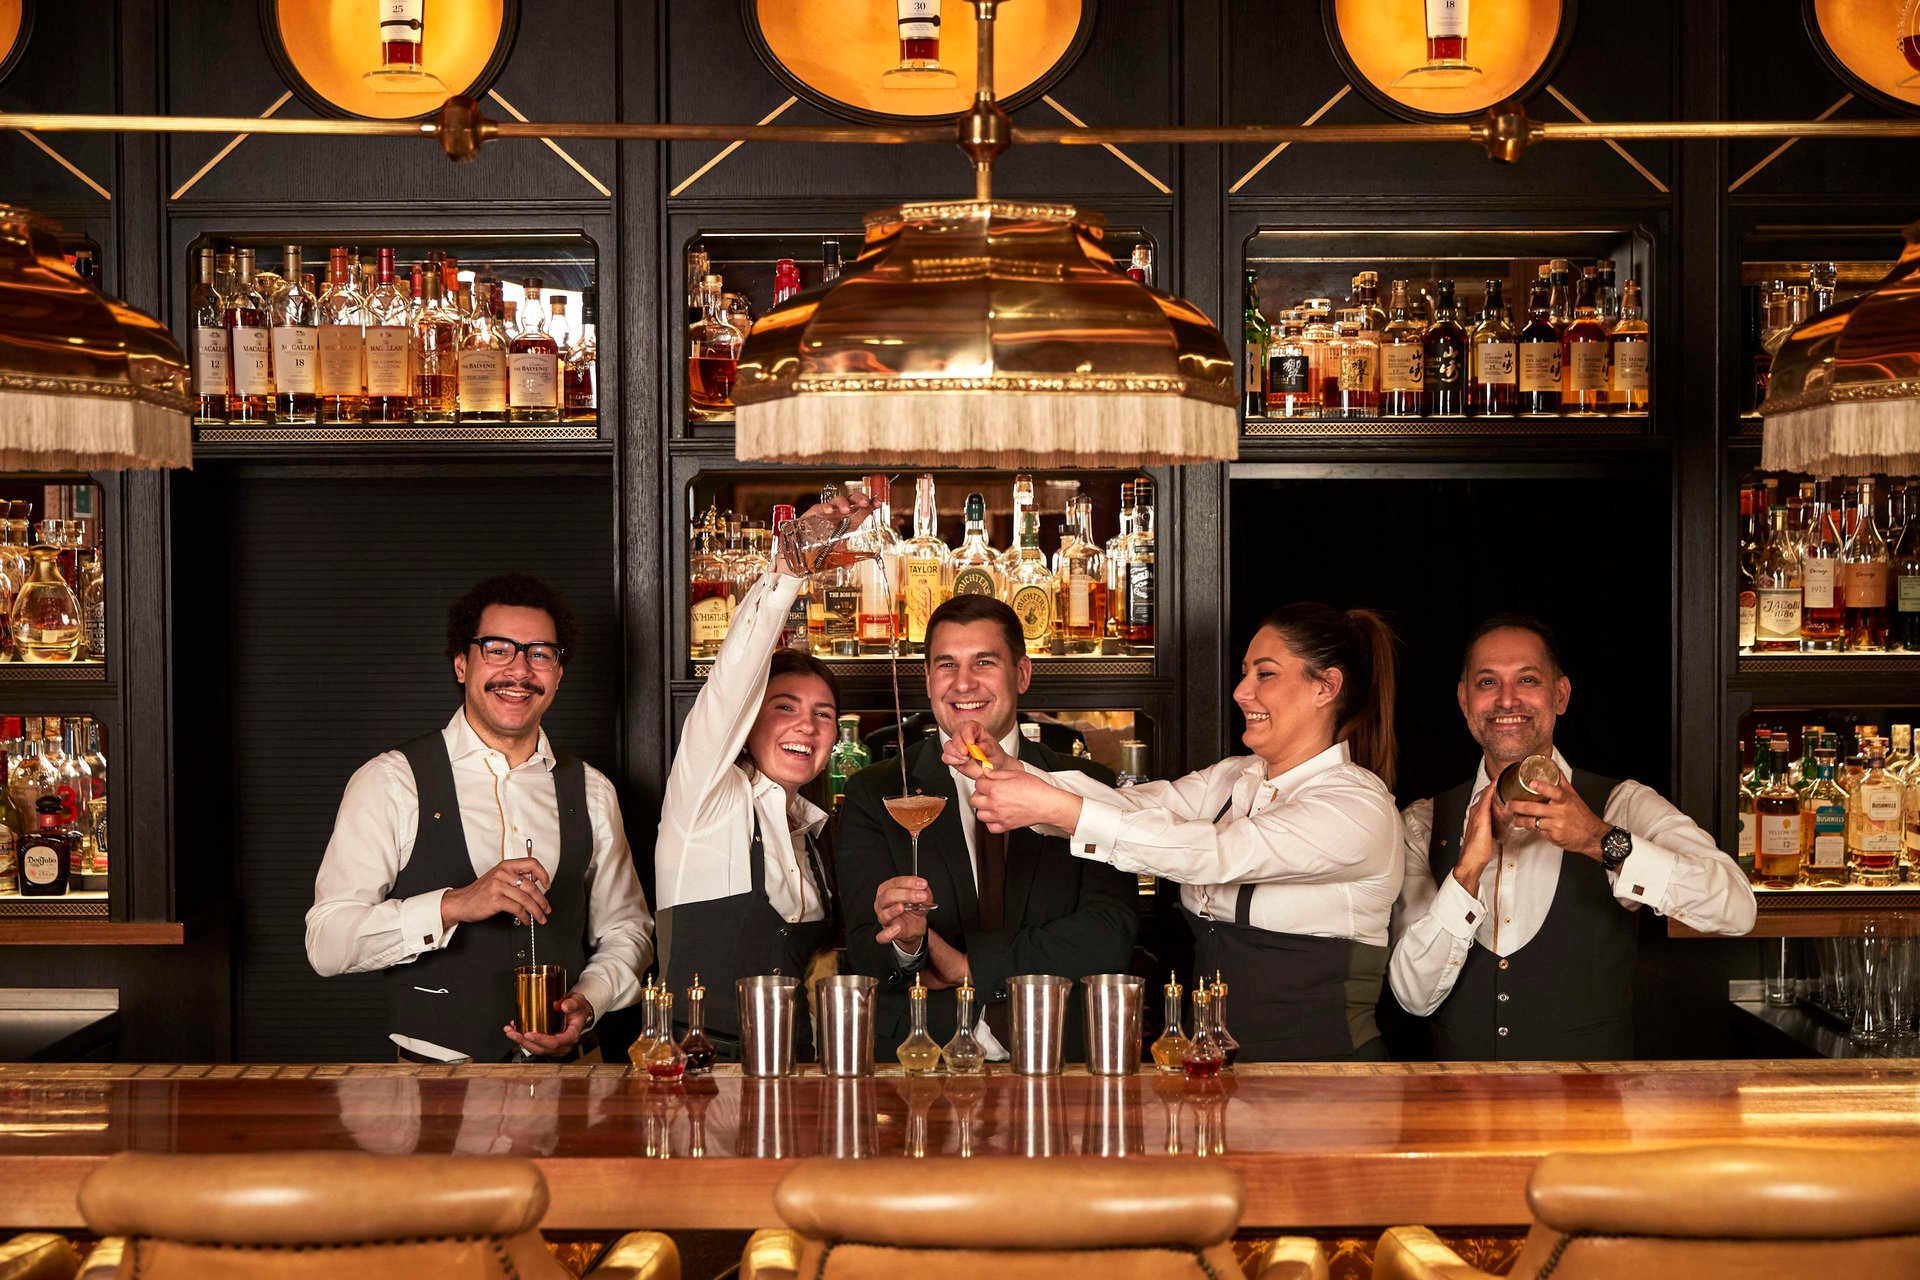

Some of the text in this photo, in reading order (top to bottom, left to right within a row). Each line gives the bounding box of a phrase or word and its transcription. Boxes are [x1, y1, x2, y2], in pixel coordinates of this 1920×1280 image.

[914, 2, 926, 10] 30
[1446, 0, 1455, 8] 18
[392, 5, 404, 13] 25
[211, 360, 220, 368] 12
[256, 360, 264, 368] 15
[909, 565, 938, 574] TAYLOR
[957, 573, 991, 595] MICHTER'S
[713, 629, 720, 638] 10
[57, 785, 79, 824] 3
[1871, 801, 1897, 809] BUSHMILLS
[1816, 815, 1845, 823] BUSHMILLS
